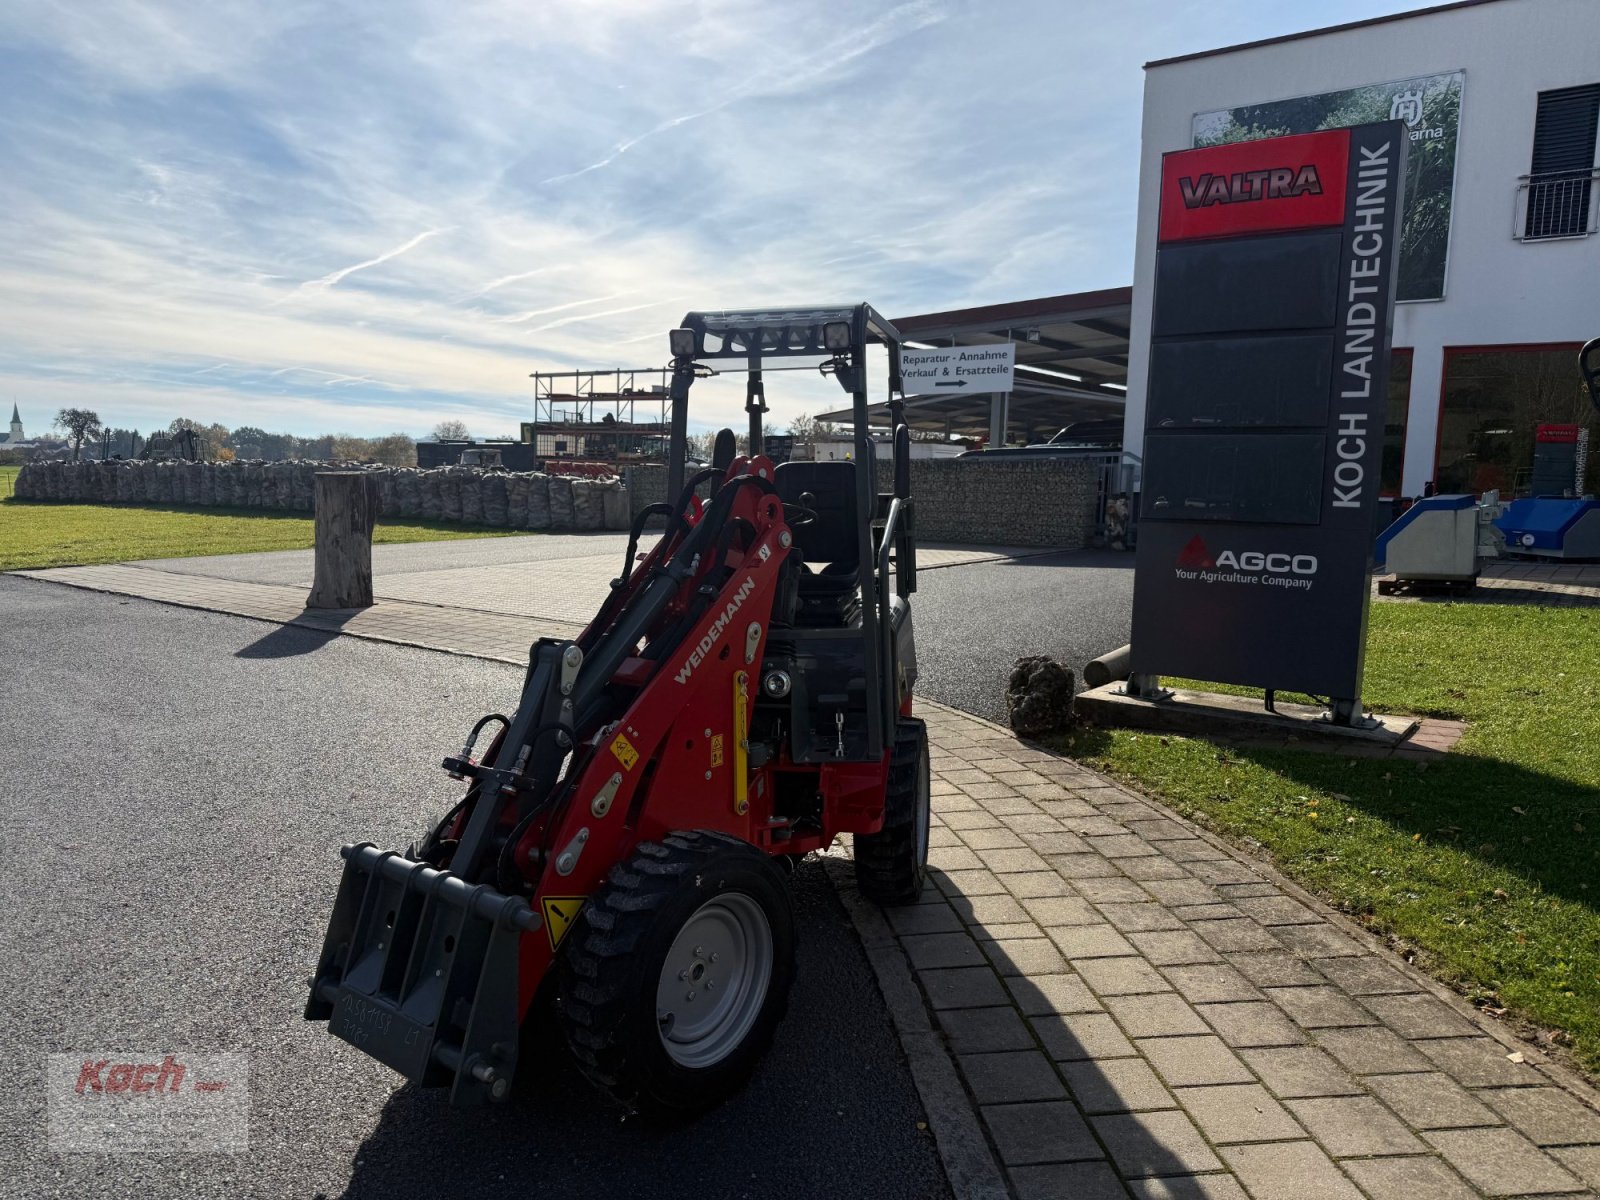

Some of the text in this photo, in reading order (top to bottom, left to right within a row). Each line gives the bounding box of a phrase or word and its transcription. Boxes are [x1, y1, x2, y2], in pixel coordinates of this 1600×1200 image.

[1178, 164, 1323, 209] VALTRA
[1332, 141, 1391, 508] KOCH LANDTECHNIK
[903, 354, 950, 366] Reparatur
[959, 351, 1008, 361] Annahme
[901, 365, 1009, 378] Verkauf & Ersatzteile
[1215, 550, 1318, 574] AGCO
[1175, 569, 1313, 590] Your Agriculture Company
[673, 576, 756, 685] WEIDEMANN
